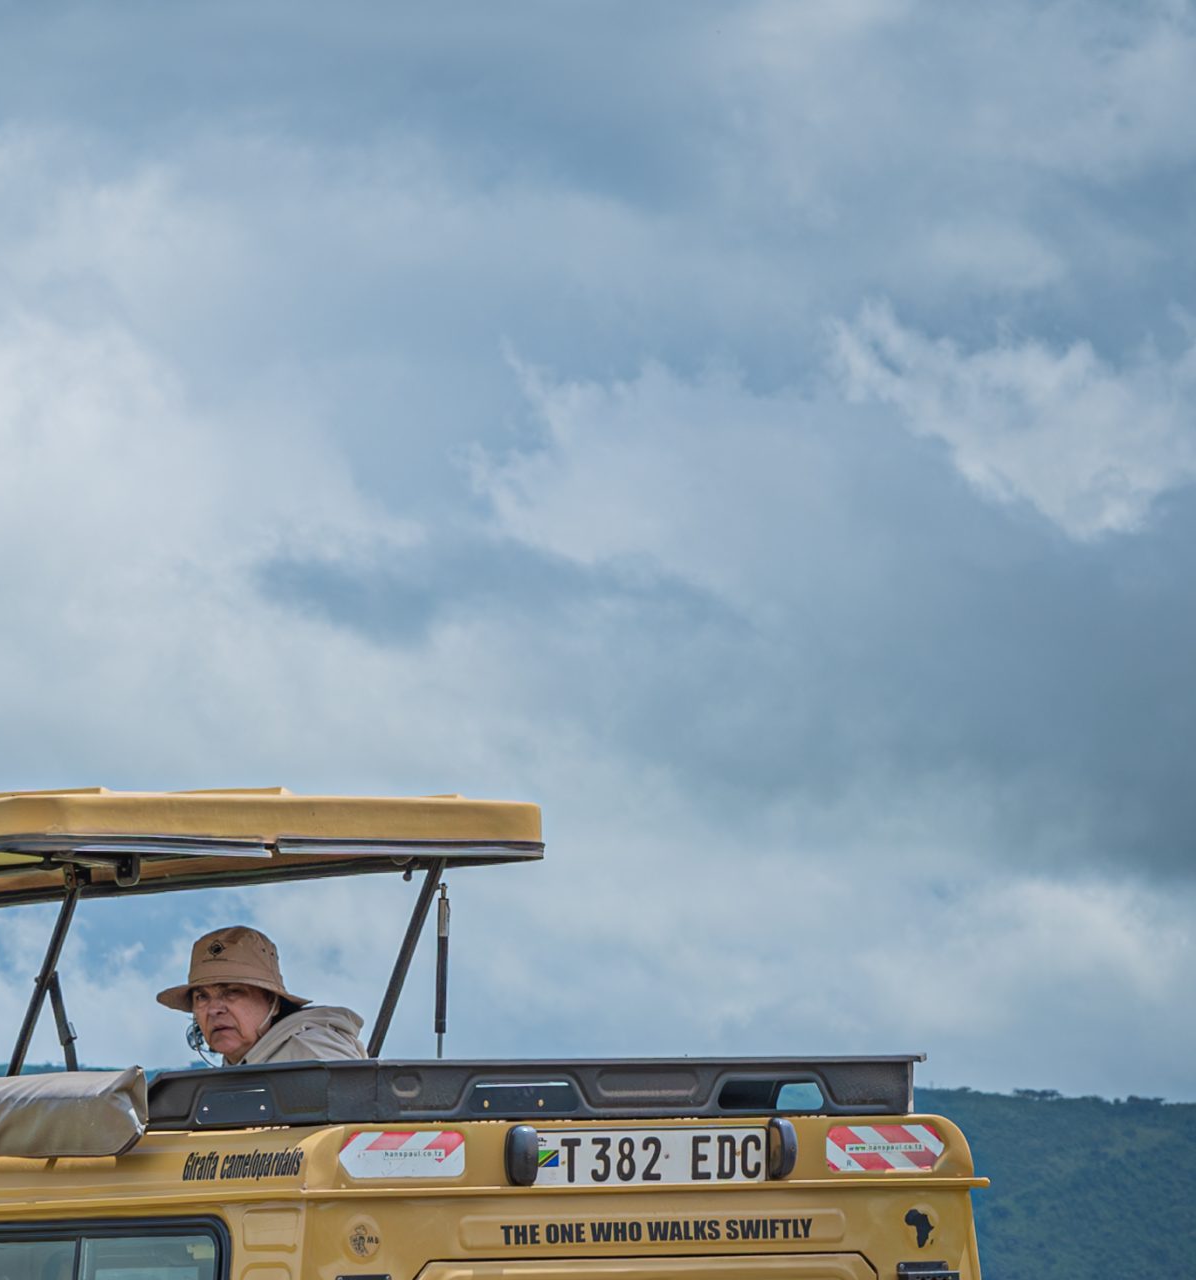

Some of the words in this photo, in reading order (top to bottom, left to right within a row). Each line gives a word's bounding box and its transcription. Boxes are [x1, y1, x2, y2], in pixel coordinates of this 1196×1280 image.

[182, 1151, 219, 1181] Giraffa
[219, 1147, 304, 1181] camelopardalis
[560, 1137, 582, 1183] T
[590, 1136, 662, 1182] 382
[691, 1134, 762, 1180] EDC
[500, 1224, 541, 1246] THE
[545, 1222, 585, 1245] ONE
[590, 1221, 643, 1242] WHO
[646, 1219, 721, 1241] WALKS
[725, 1217, 813, 1239] SWIFTLY
